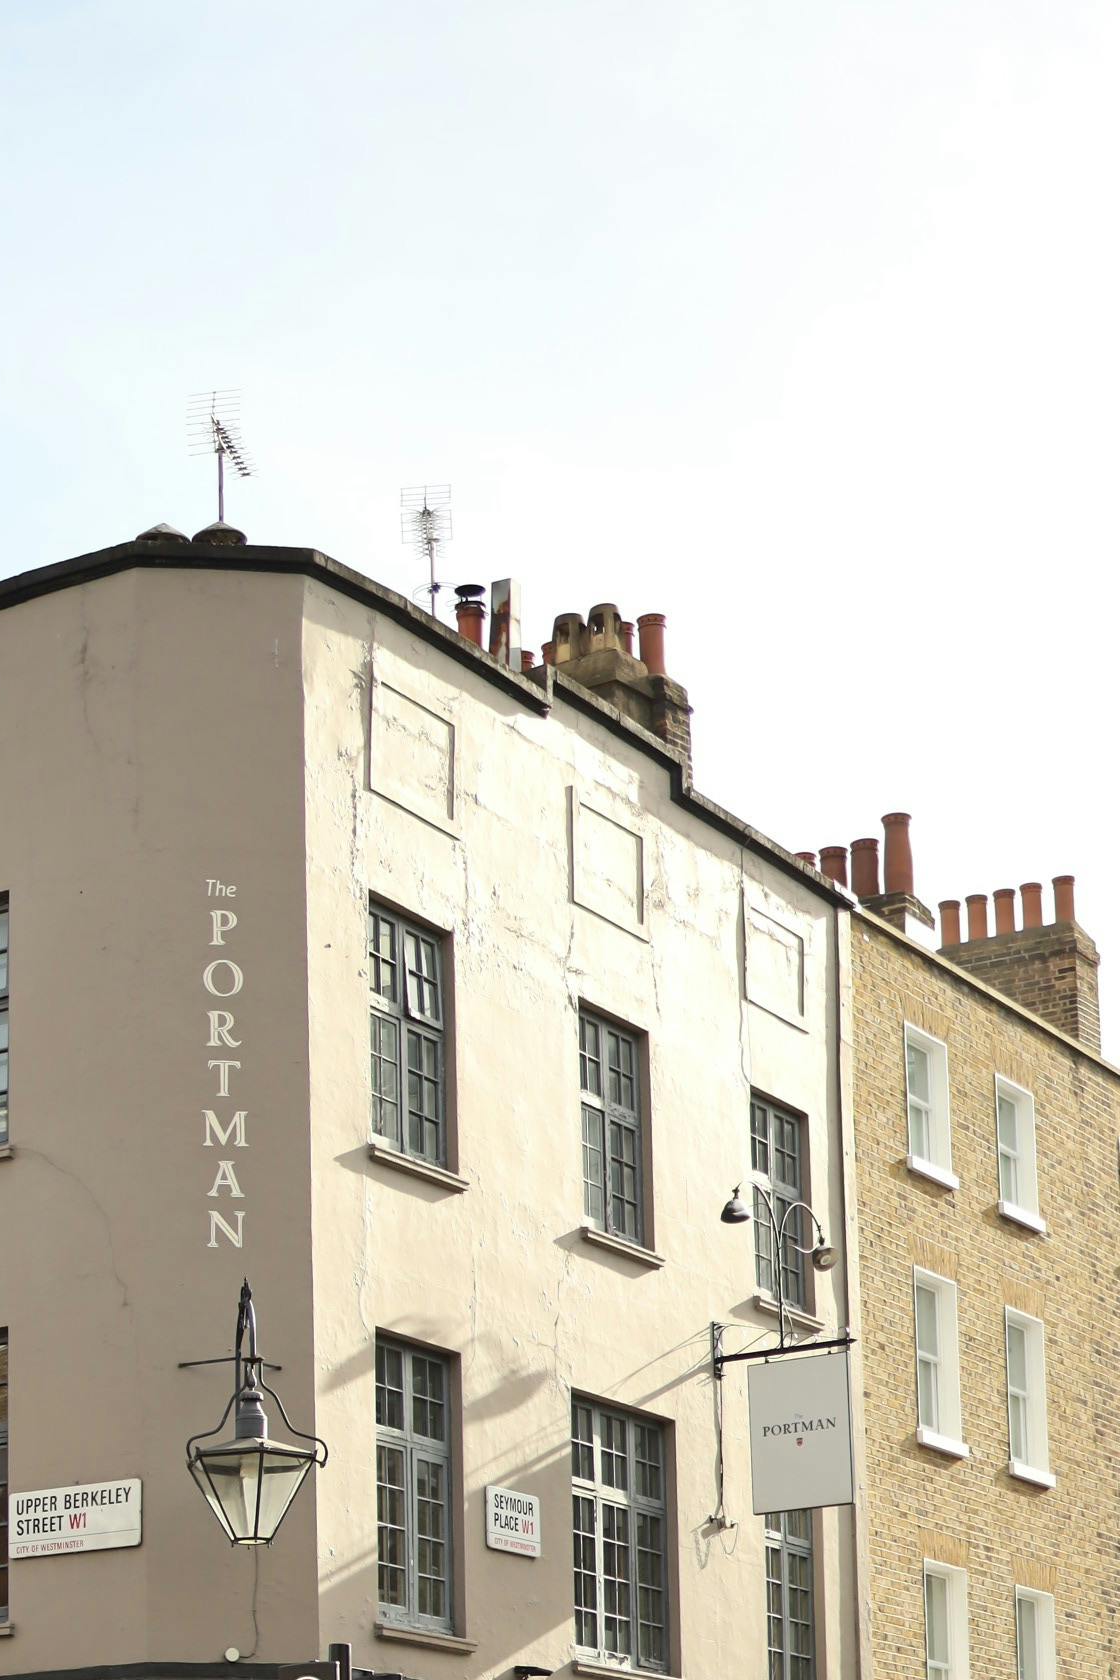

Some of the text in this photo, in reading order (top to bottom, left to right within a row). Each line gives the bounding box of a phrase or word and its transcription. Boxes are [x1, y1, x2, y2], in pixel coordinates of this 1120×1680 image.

[206, 879, 237, 897] The
[202, 909, 249, 1249] PORTMAN
[762, 1416, 837, 1438] PORTMAN
[16, 1486, 132, 1516] UPPER BERKELEY
[494, 1493, 534, 1517] SEYMOUR
[16, 1512, 87, 1536] STREET W1
[493, 1512, 534, 1536] PLACE W1
[16, 1539, 85, 1555] CITY OF WESTMINSTER
